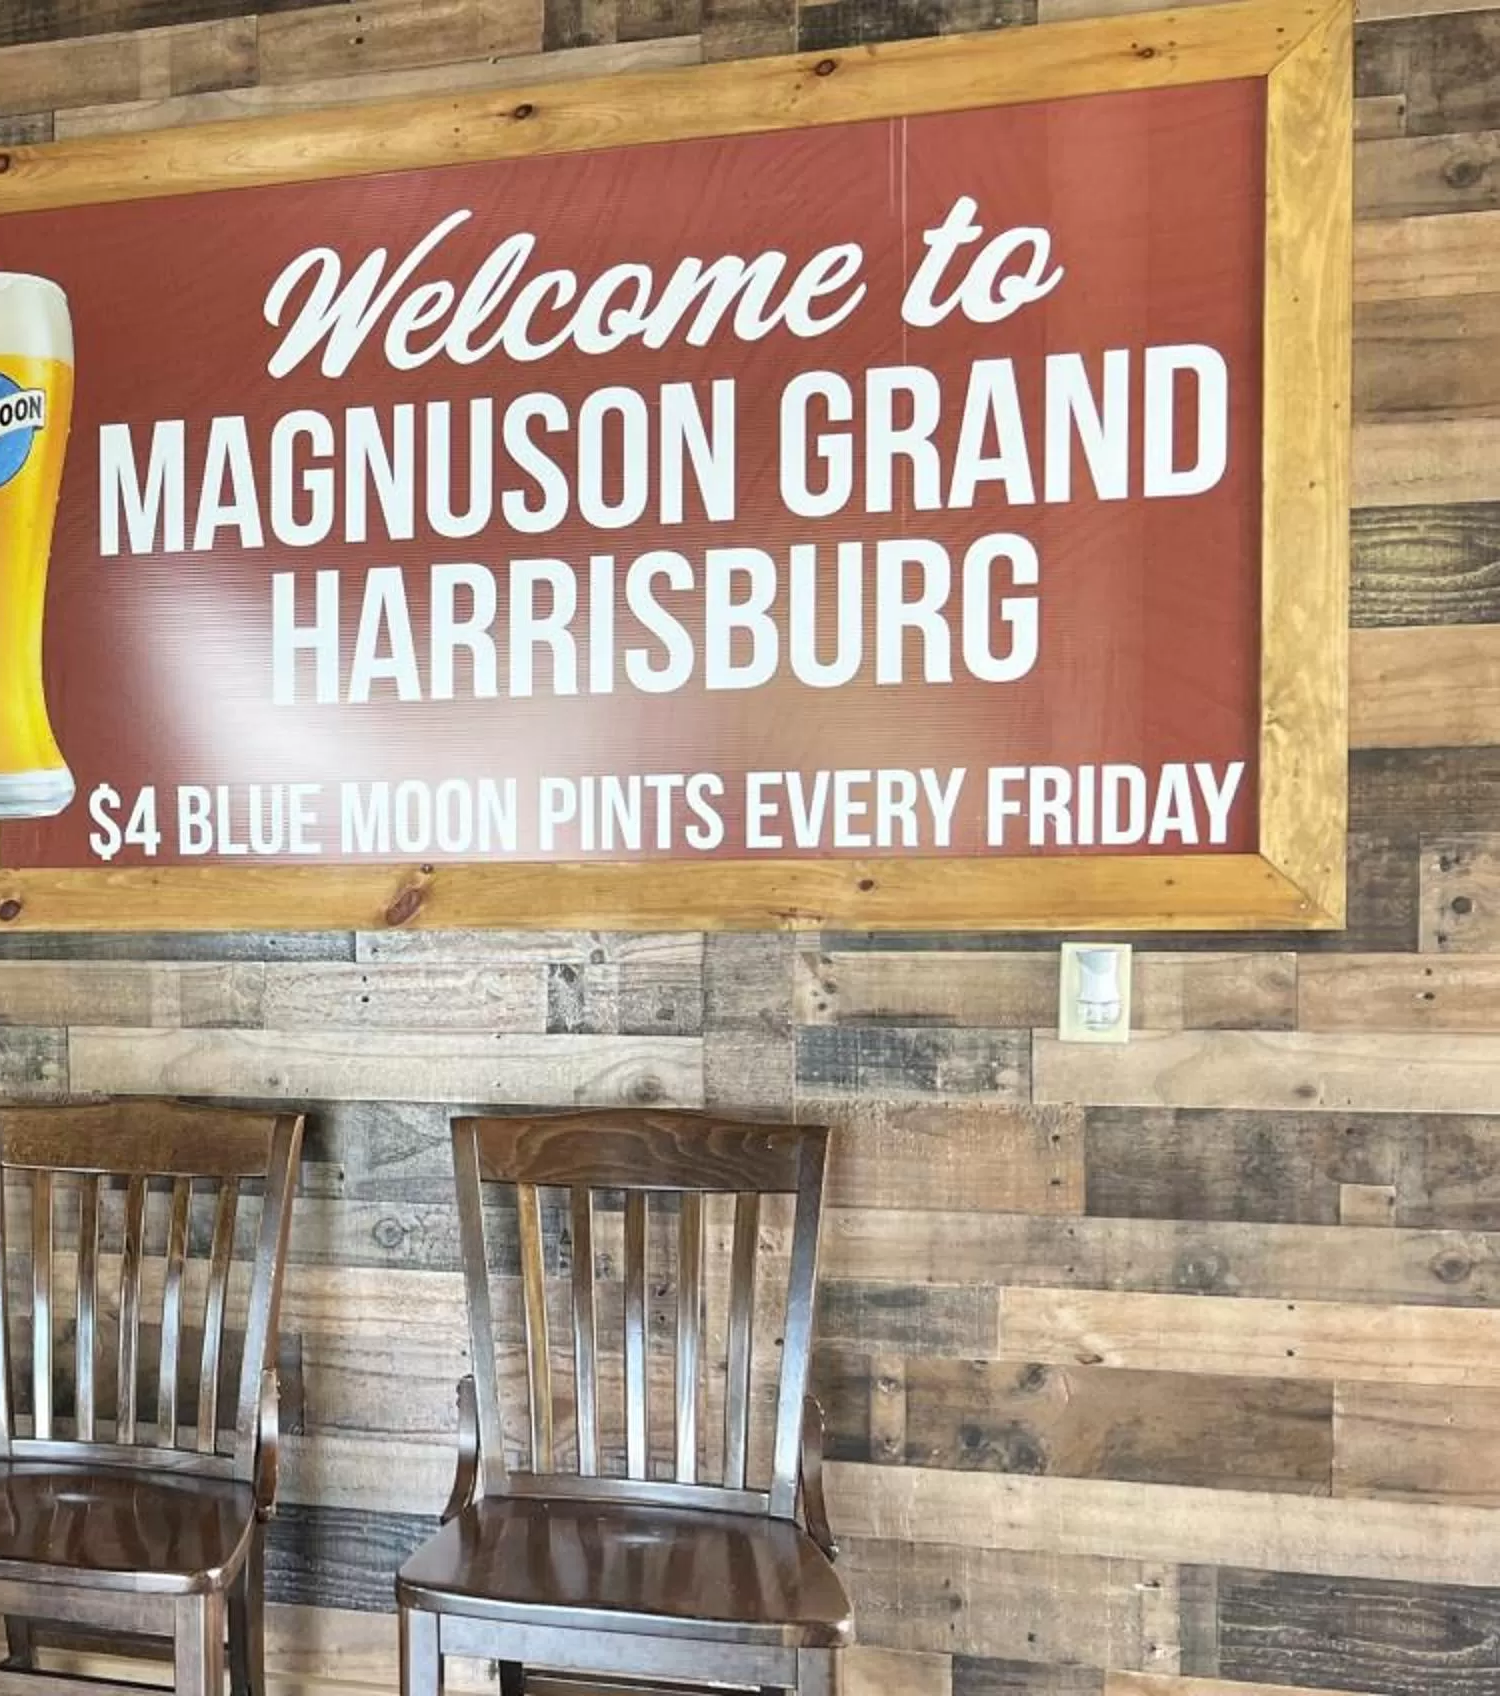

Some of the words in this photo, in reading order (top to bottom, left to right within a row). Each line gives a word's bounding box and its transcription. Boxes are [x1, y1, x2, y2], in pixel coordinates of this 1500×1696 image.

[263, 209, 867, 379] Welcome
[901, 195, 1065, 328] to
[99, 378, 736, 557] MAGNUSON
[779, 343, 1228, 518] GRAND
[271, 532, 1039, 705] HARRISBURG
[88, 783, 162, 862] $4
[177, 782, 323, 857] BLUE
[340, 777, 517, 855] MOON
[538, 773, 725, 852] PINTS
[745, 767, 966, 849] EVERY
[987, 761, 1245, 847] FRIDAY
